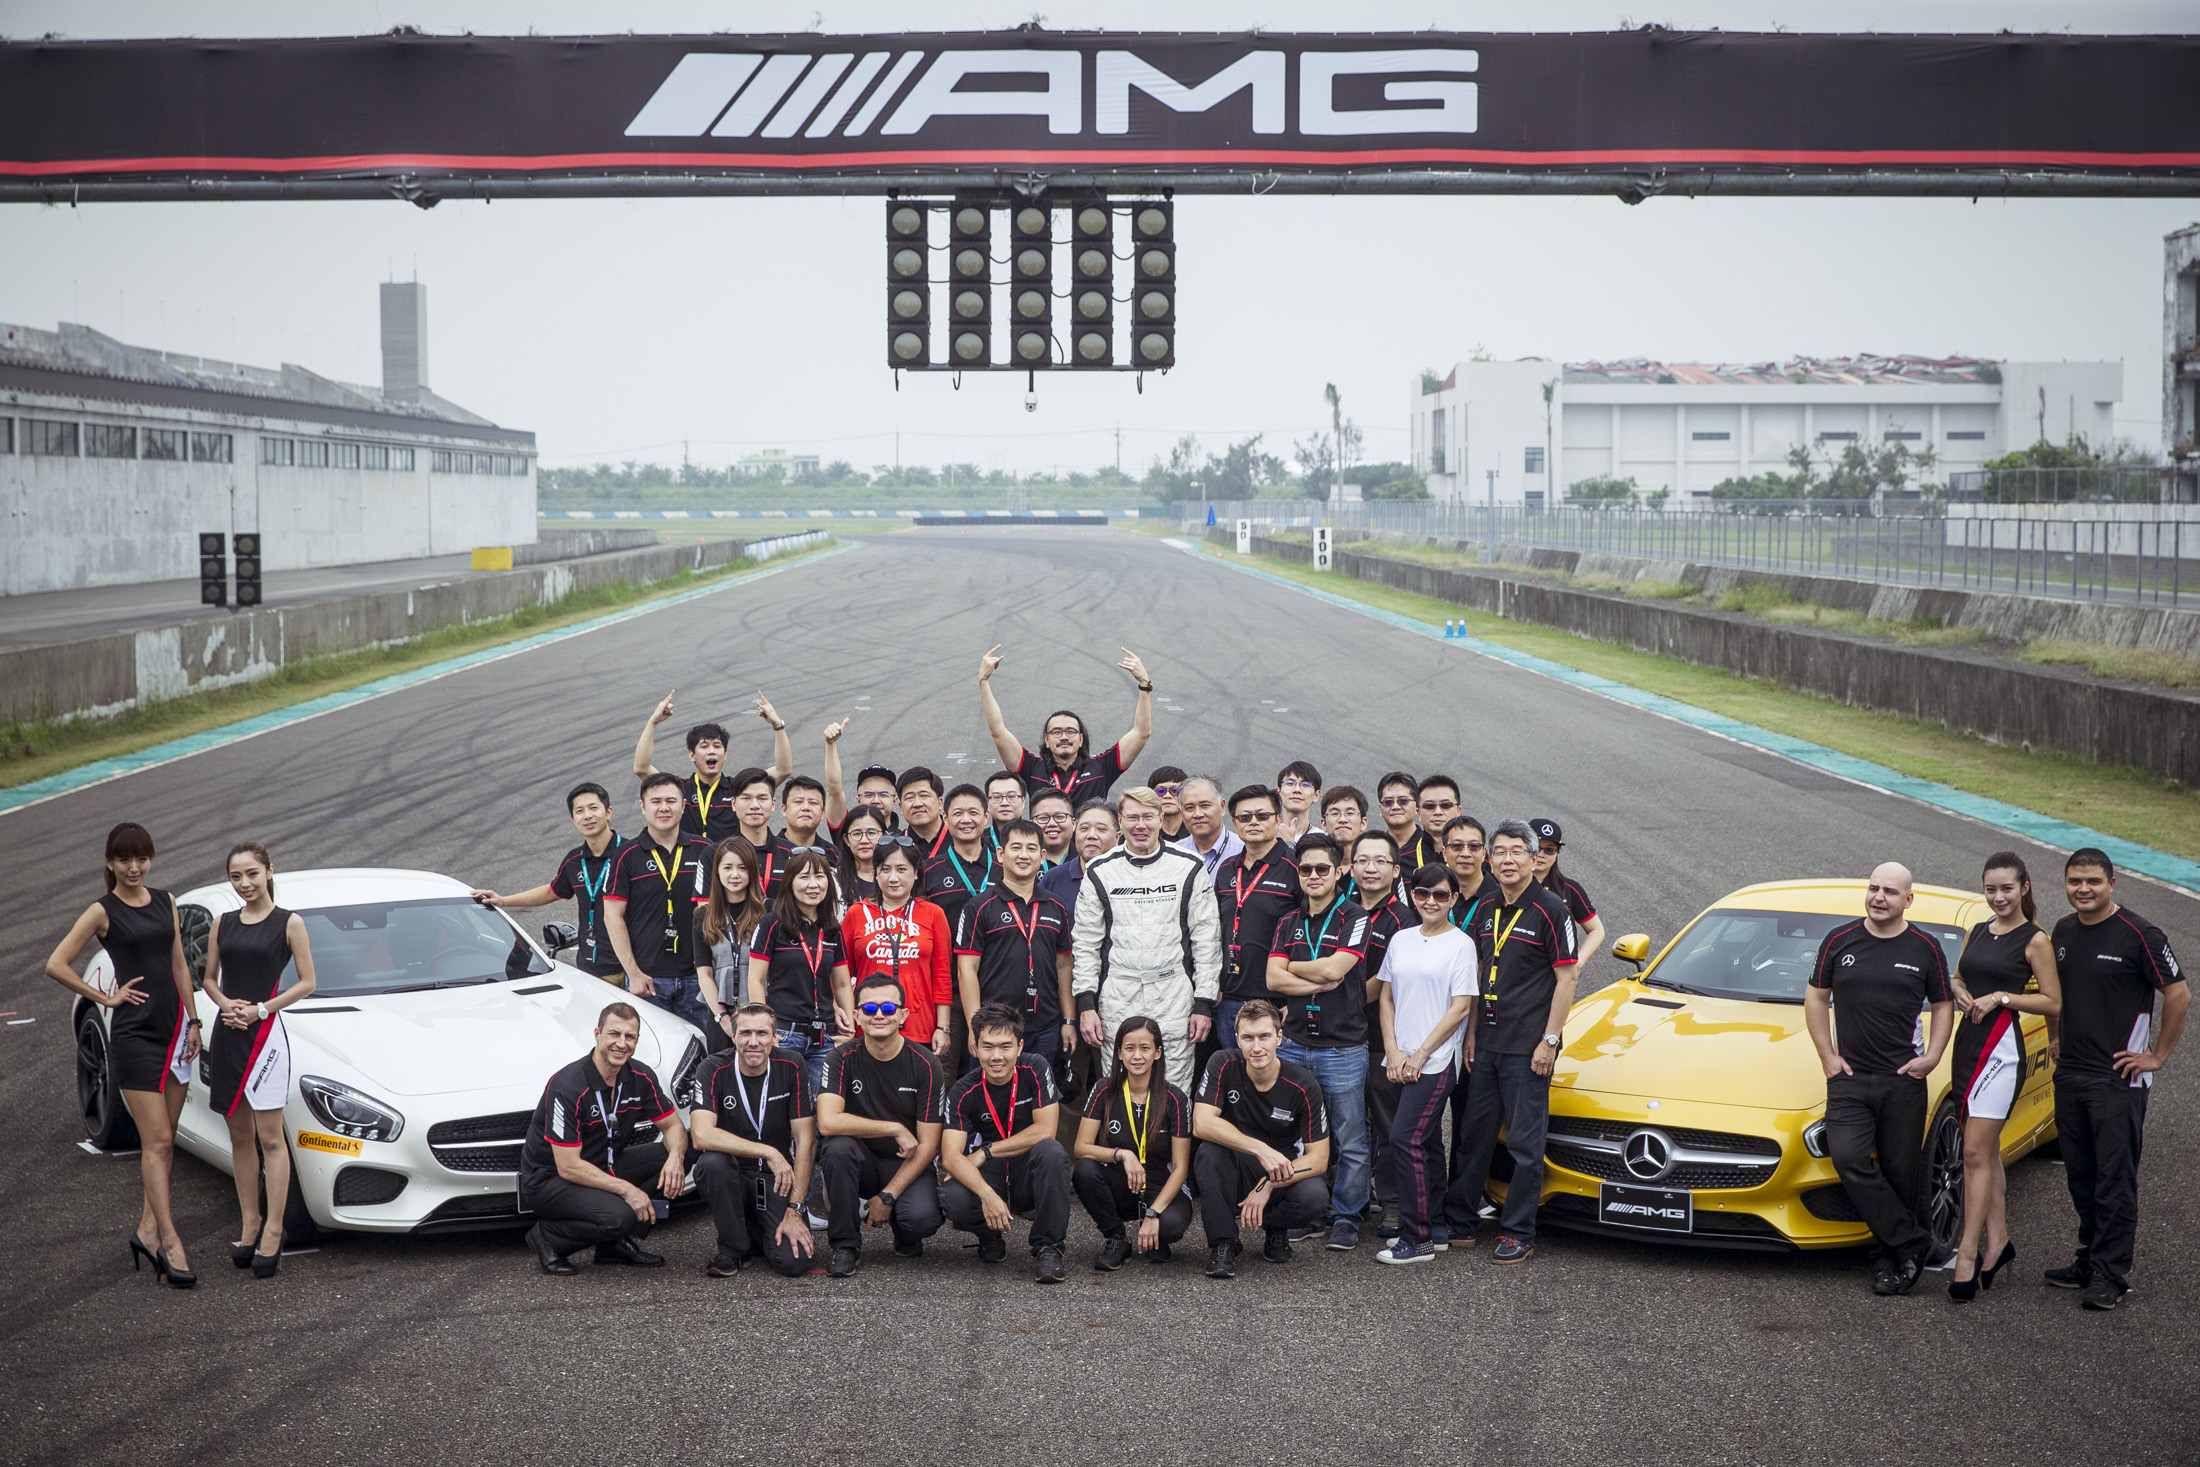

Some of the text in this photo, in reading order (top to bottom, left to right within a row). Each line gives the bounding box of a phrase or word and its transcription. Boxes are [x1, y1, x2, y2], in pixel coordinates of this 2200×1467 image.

[879, 49, 1479, 135] AMG
[1318, 529, 1327, 566] 100
[1130, 884, 1177, 895] AMG
[865, 939, 920, 959] Canda
[258, 1048, 277, 1081] AMG
[1979, 1058, 2003, 1088] AMG
[299, 1133, 351, 1151] Continental
[1628, 1205, 1685, 1219] AMG
